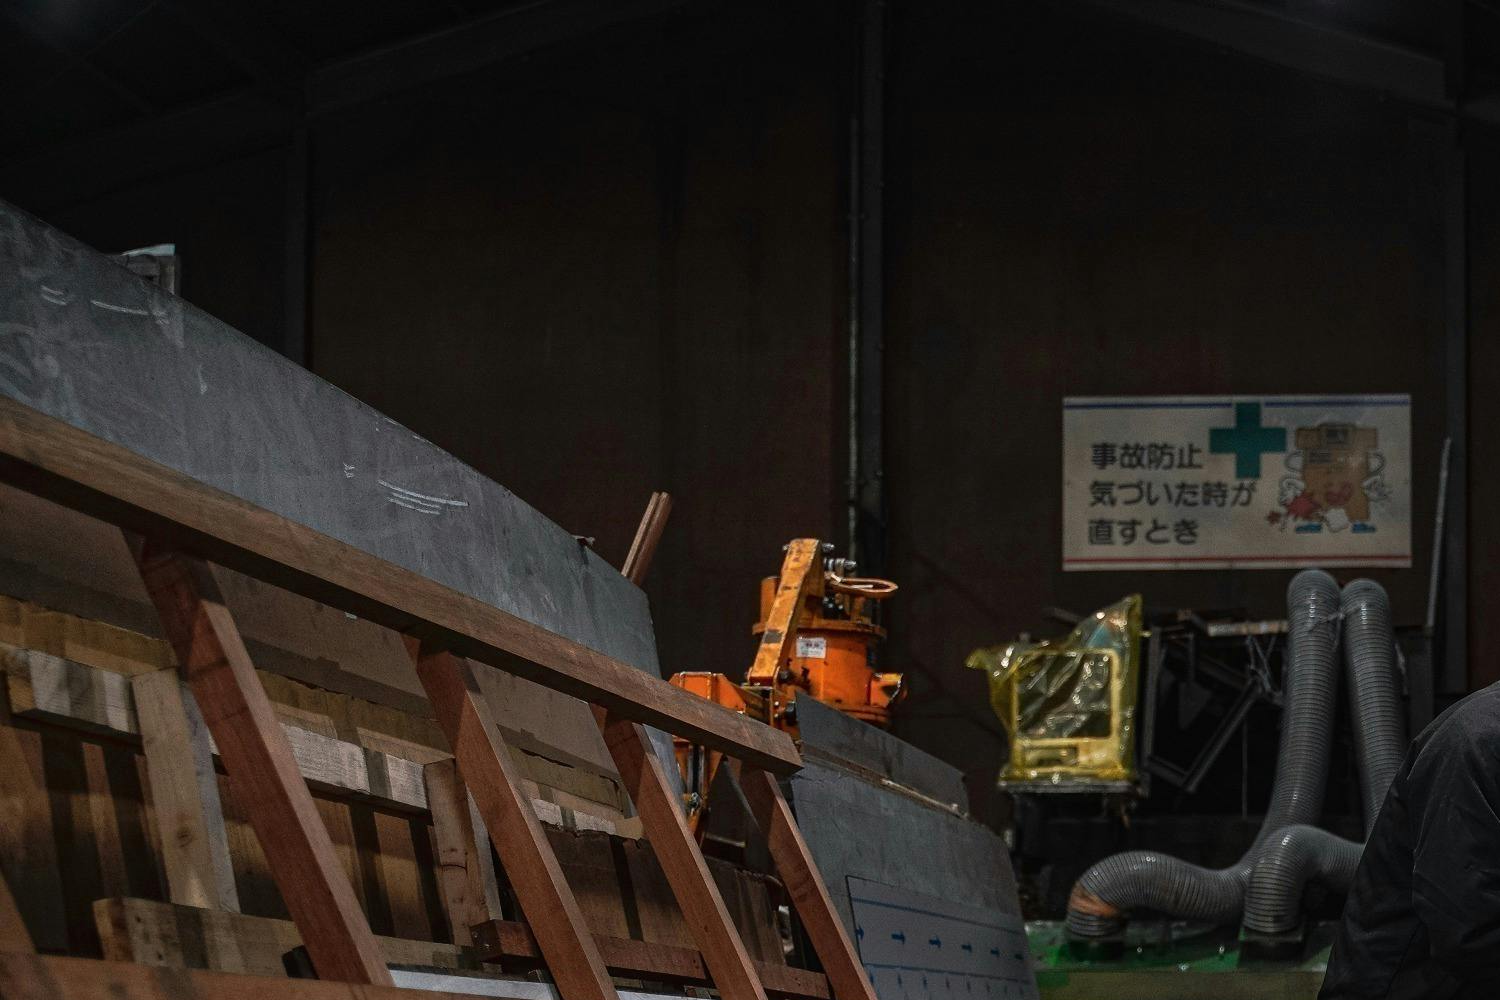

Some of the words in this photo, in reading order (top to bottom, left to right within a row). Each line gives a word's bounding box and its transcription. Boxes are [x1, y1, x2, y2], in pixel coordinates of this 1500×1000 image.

[1091, 443, 1203, 470] 事故防止
[1090, 480, 1256, 507] 気づいた時が
[1089, 518, 1199, 546] 直すとき
